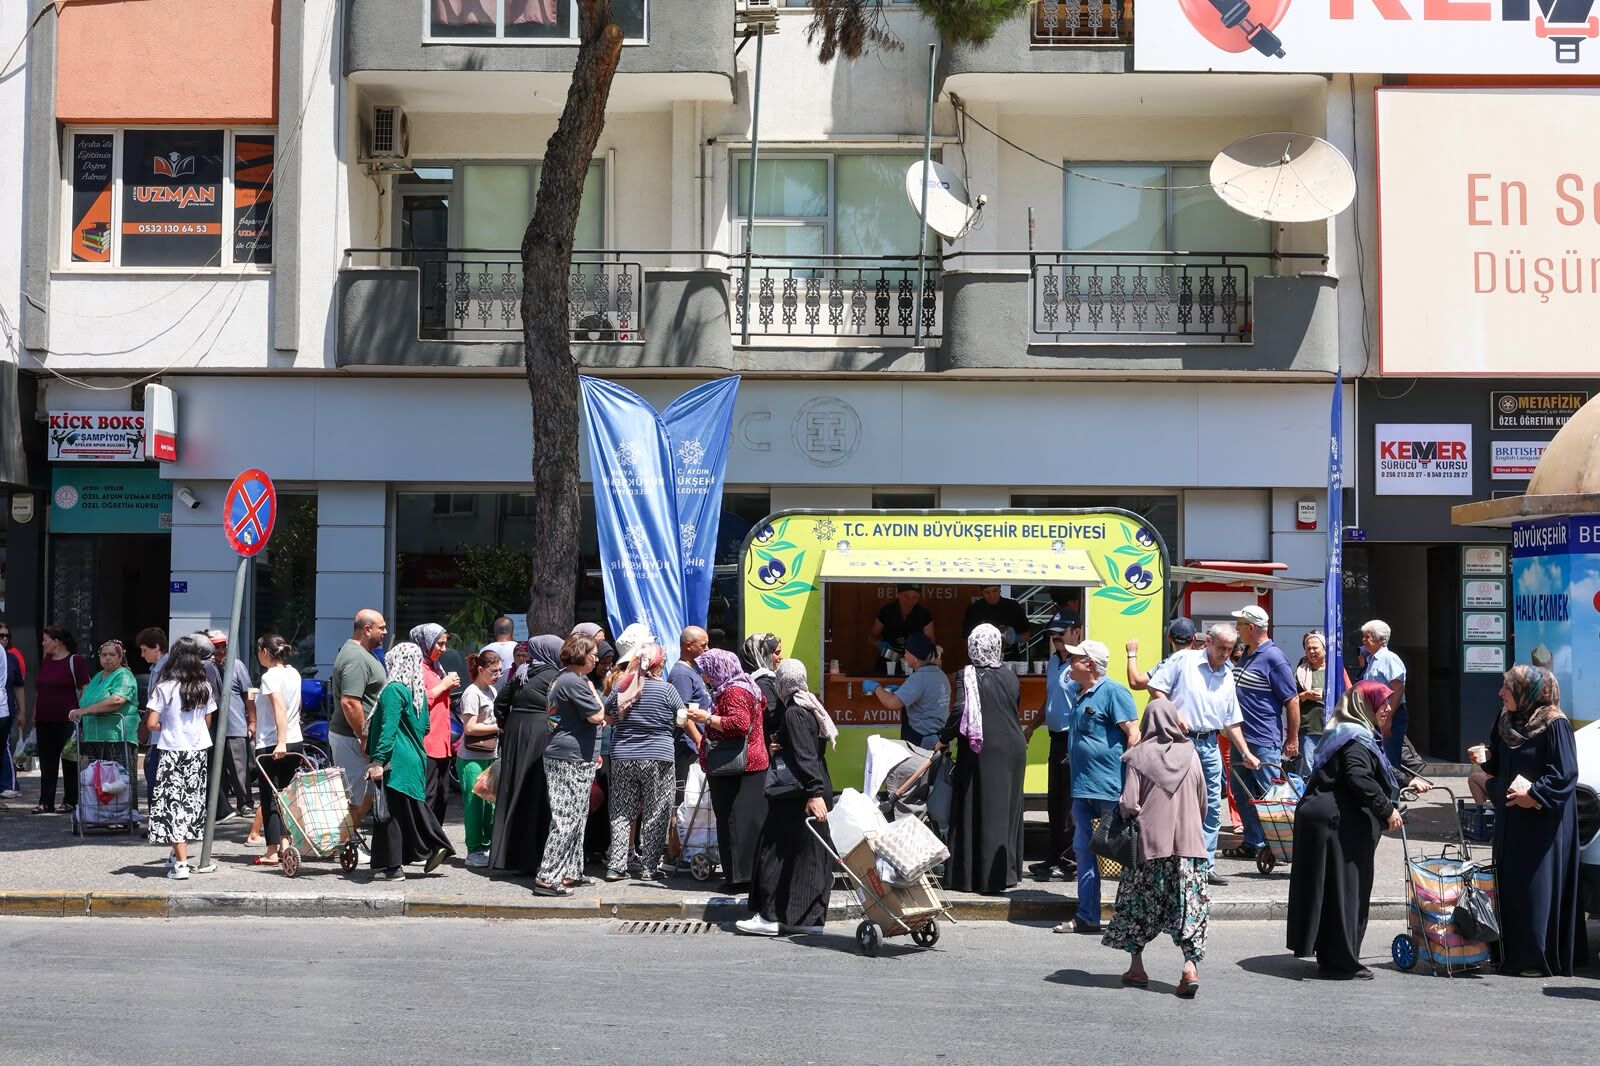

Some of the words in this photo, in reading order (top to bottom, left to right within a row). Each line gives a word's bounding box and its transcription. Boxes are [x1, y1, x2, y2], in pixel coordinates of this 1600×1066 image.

[136, 186, 215, 209] UZMAN
[1468, 173, 1527, 226] En
[138, 224, 162, 233] 0532
[164, 224, 180, 233] 130
[181, 224, 194, 233] 64
[196, 224, 208, 233] 53
[1518, 394, 1582, 409] METAFİZİK
[49, 412, 94, 430] KİCK
[97, 415, 145, 430] BOKS
[1499, 415, 1518, 426] ÖZEL
[1519, 415, 1554, 426] ÖĞRETİM
[81, 432, 126, 443] ŞAMPİYON
[1380, 441, 1468, 460] KEMER
[1381, 460, 1417, 470] SÜRÜCÜ
[1435, 461, 1468, 470] KURSU
[843, 522, 869, 537] T.C.
[872, 523, 918, 537] AYDIN
[923, 520, 1018, 541] BÜYÜKŞEHİR
[1021, 522, 1106, 540] BELEDİYESİ
[1513, 522, 1567, 551] BÜYÜKŞEHİR
[877, 587, 958, 599] BELİYESİ
[1515, 594, 1537, 622] HALK
[1538, 594, 1569, 622] EKMEK
[835, 710, 857, 721] T.C.
[863, 710, 900, 721] AYDIN
